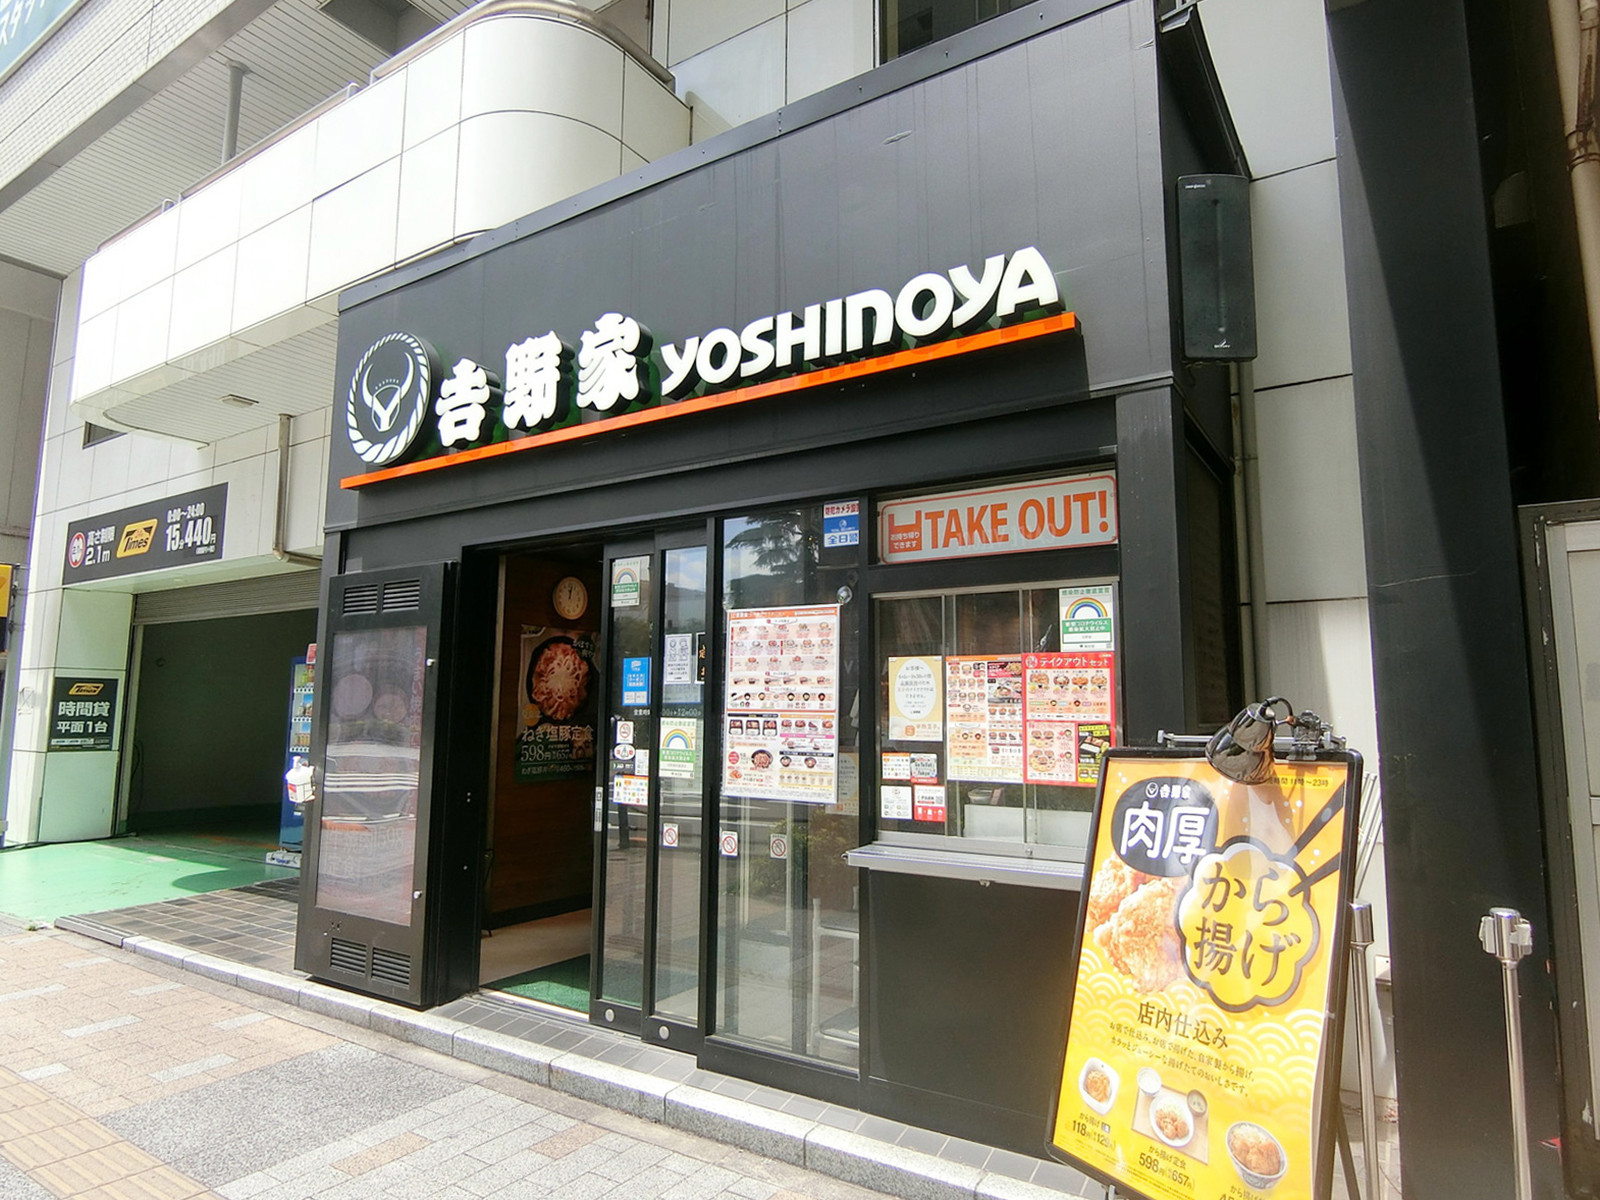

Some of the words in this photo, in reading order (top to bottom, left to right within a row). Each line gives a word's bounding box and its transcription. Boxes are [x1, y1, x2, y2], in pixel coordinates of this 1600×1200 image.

[659, 246, 1060, 397] YOSHINOYA
[435, 312, 643, 450] 吉野家
[925, 502, 1009, 549] TAKE
[1018, 490, 1108, 540] OUT!
[123, 531, 151, 553] Times
[890, 531, 920, 541] お持ち帰り
[893, 540, 917, 549] できます
[84, 546, 111, 566] 2.1m
[58, 701, 111, 717] 時間貸
[56, 721, 108, 733] 平面1台
[521, 724, 594, 742] ねぎ塩豚定食
[520, 744, 552, 761] 598円
[1159, 784, 1191, 799] 吉野家
[1120, 800, 1210, 865] 肉厚
[1137, 1002, 1228, 1049] 店内仕込み
[1148, 1145, 1187, 1170] から揚げ定食
